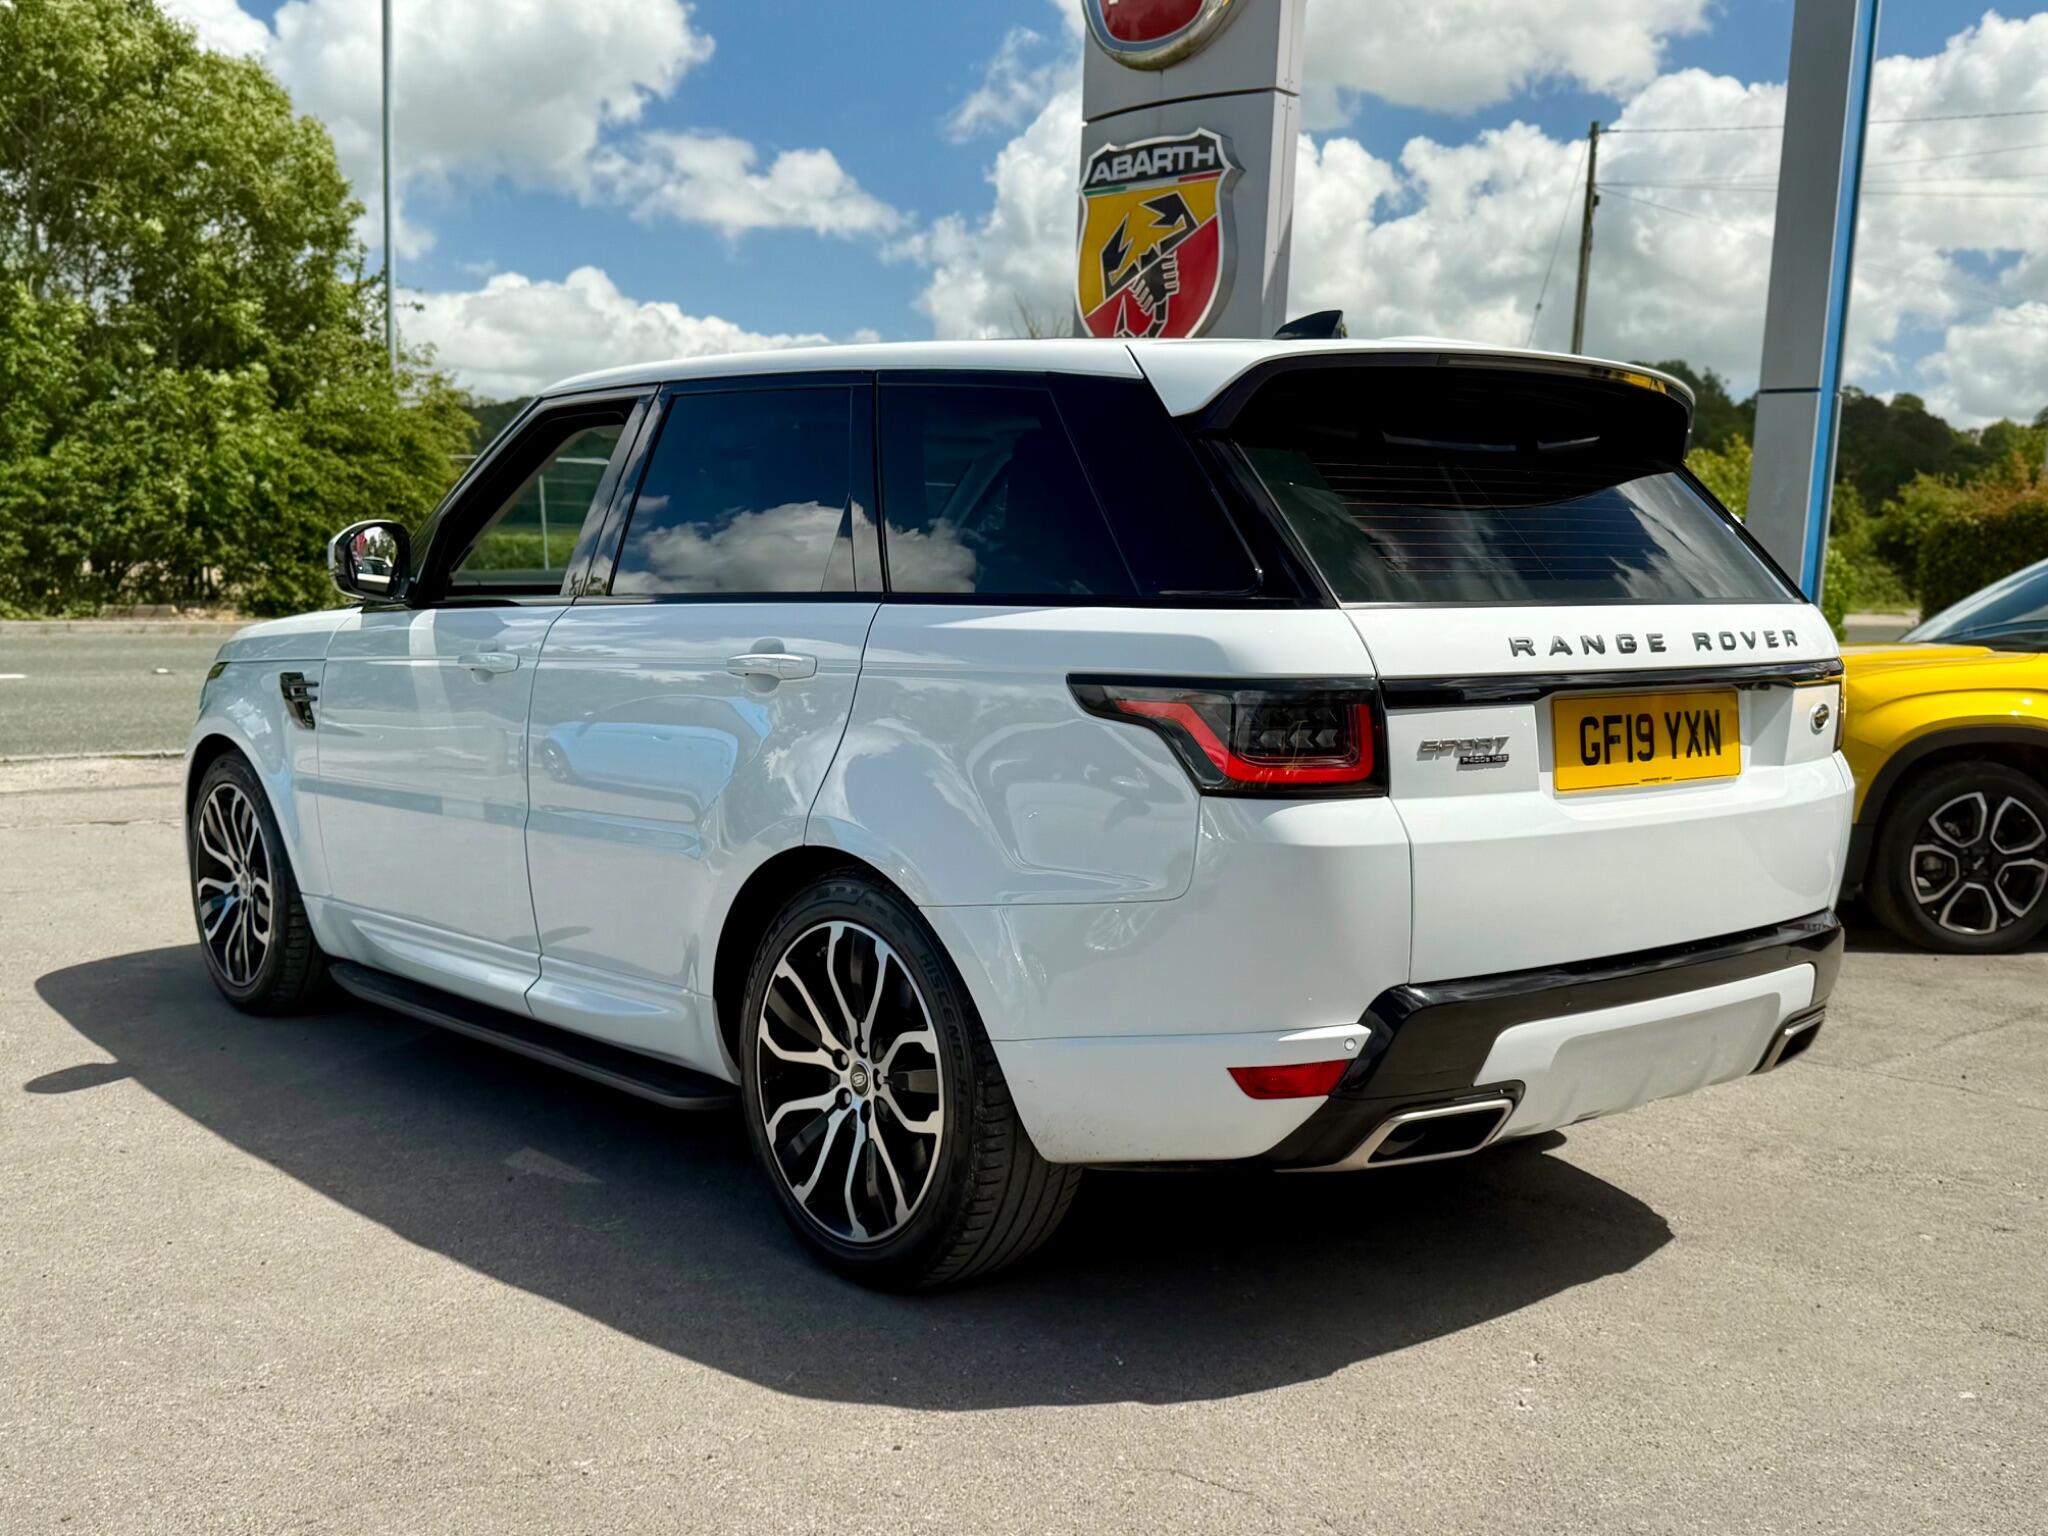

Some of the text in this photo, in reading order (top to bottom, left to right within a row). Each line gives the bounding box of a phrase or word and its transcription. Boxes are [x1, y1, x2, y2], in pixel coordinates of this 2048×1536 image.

[1090, 146, 1214, 183] ABARTH
[1508, 629, 1798, 657] RANGE ROVER
[1419, 736, 1509, 754] SPORT
[1579, 708, 1722, 766] GF19 YXN
